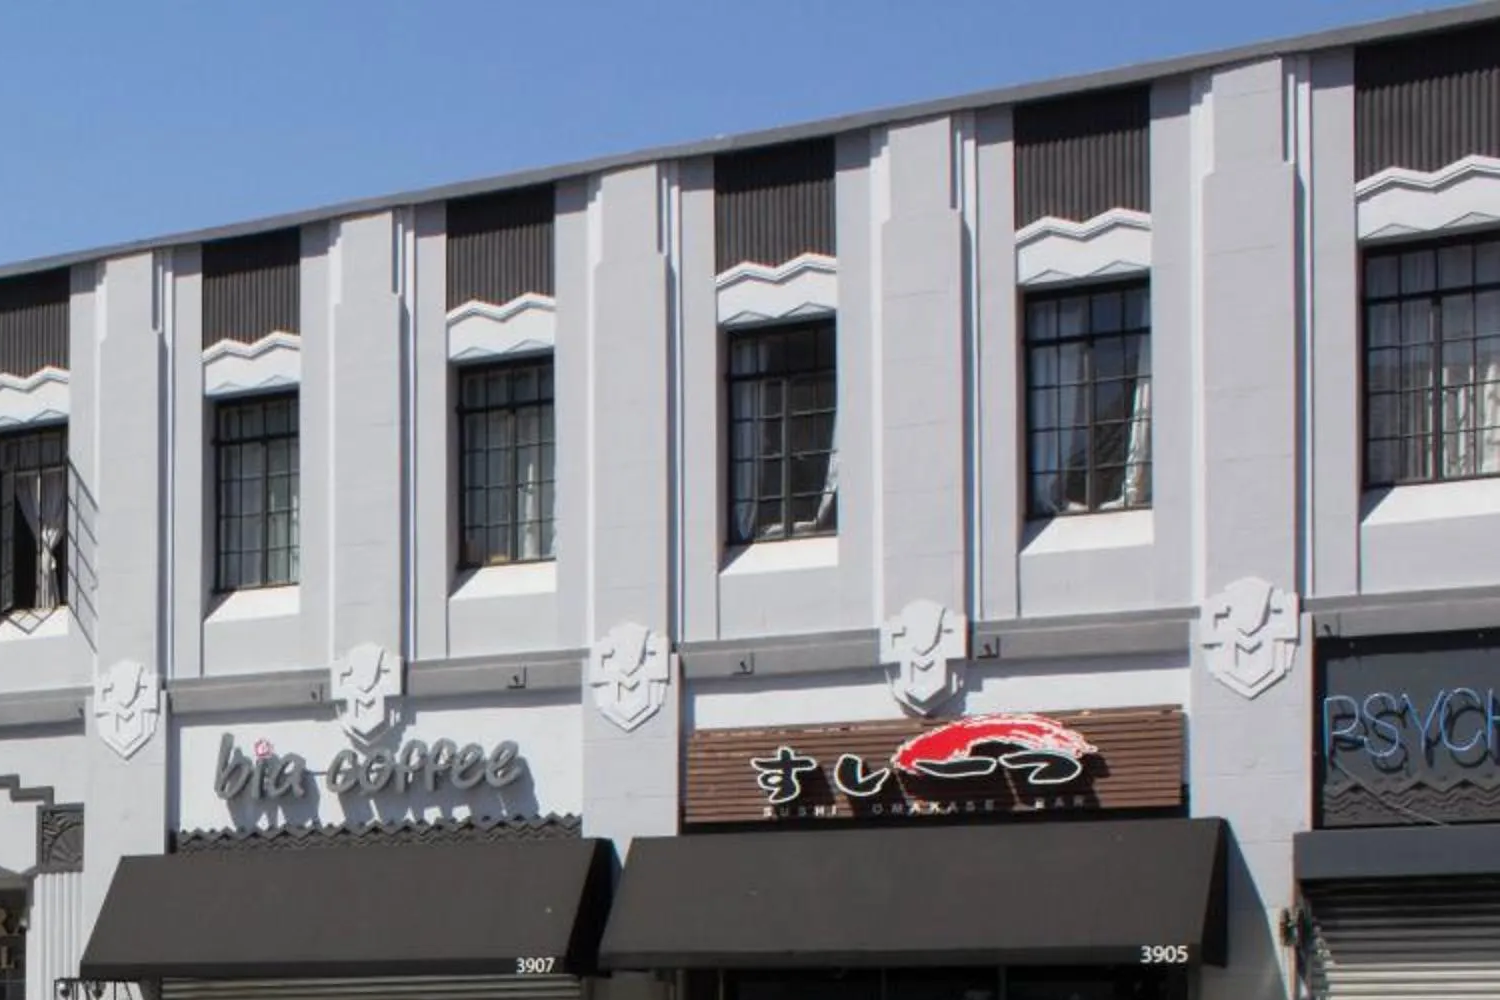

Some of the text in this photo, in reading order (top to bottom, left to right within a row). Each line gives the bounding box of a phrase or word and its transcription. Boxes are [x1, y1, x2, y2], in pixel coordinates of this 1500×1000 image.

[326, 737, 521, 794] coffee
[762, 804, 839, 818] SUSHI
[872, 800, 996, 816] OMAKASE
[1140, 945, 1188, 964] 3905
[516, 957, 555, 974] 3907
